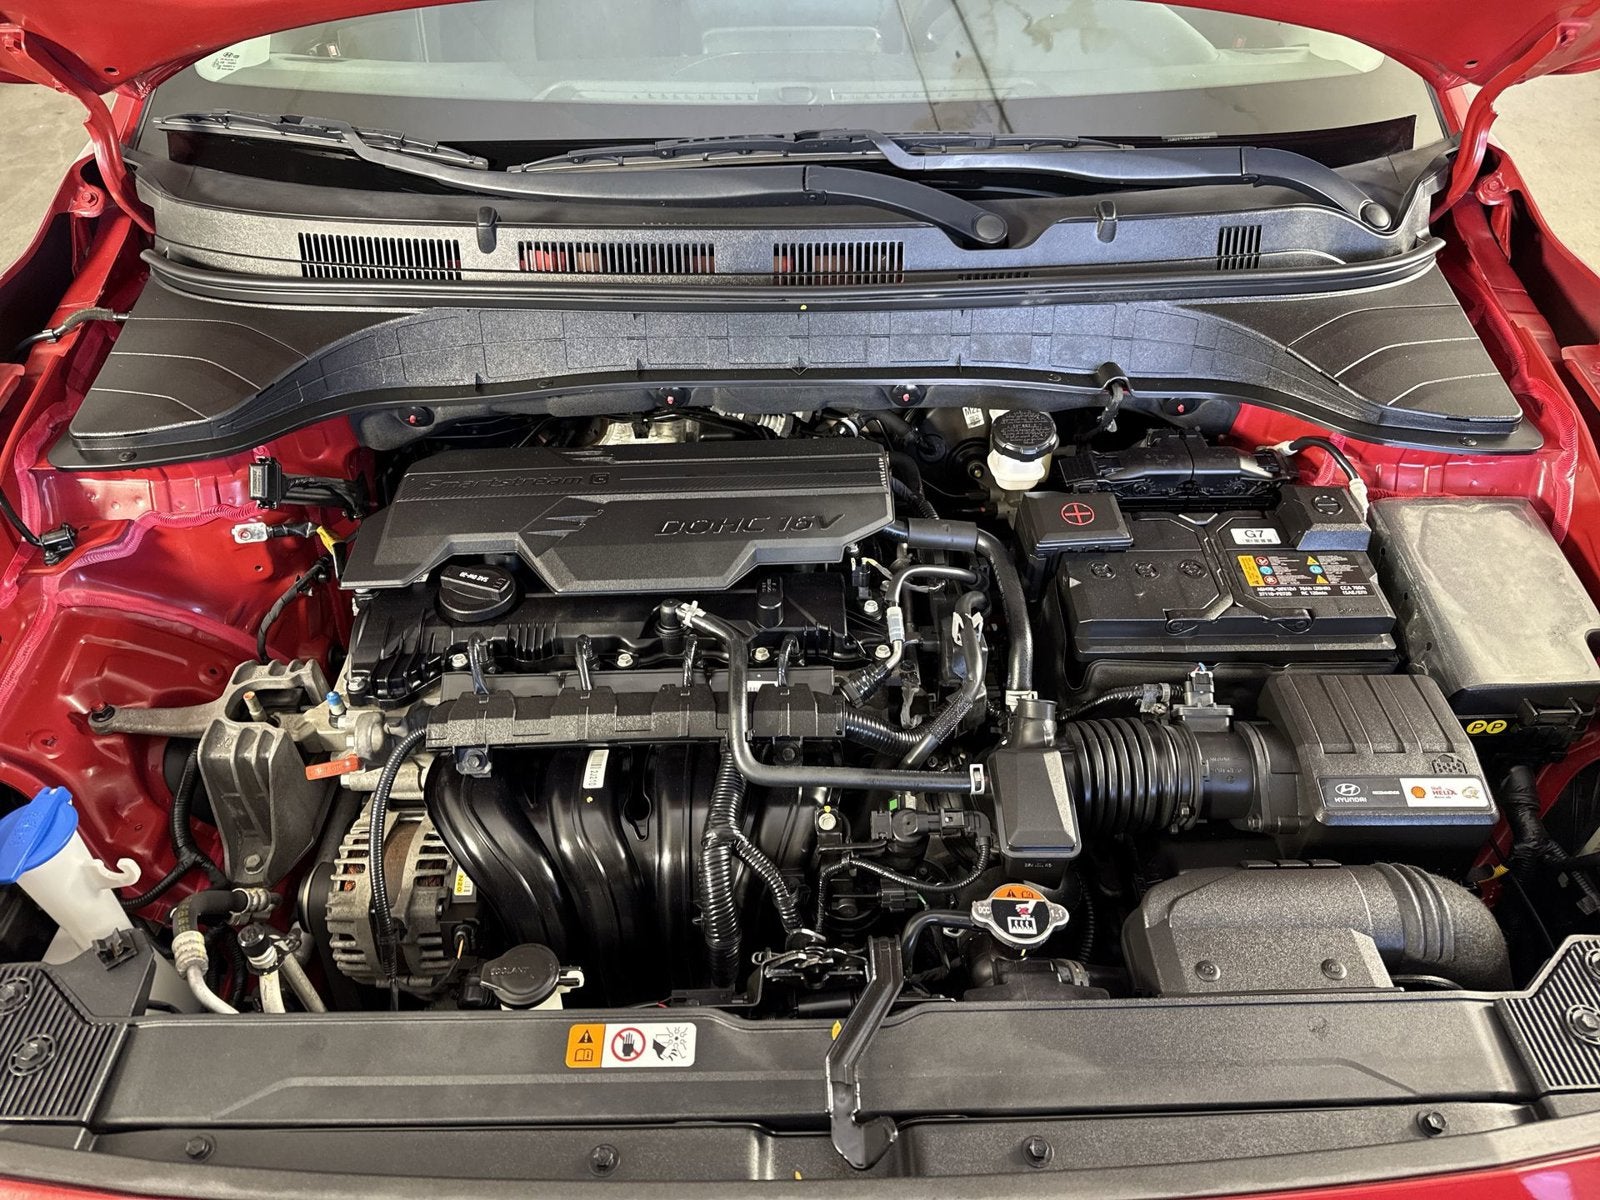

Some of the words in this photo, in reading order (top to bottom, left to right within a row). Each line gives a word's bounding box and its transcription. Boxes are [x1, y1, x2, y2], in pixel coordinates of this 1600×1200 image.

[421, 476, 584, 490] Smartstream
[655, 516, 771, 537] DOHC
[779, 513, 846, 533] 16V
[1244, 530, 1264, 538] G7
[1471, 723, 1484, 732] P
[1490, 723, 1504, 732] P
